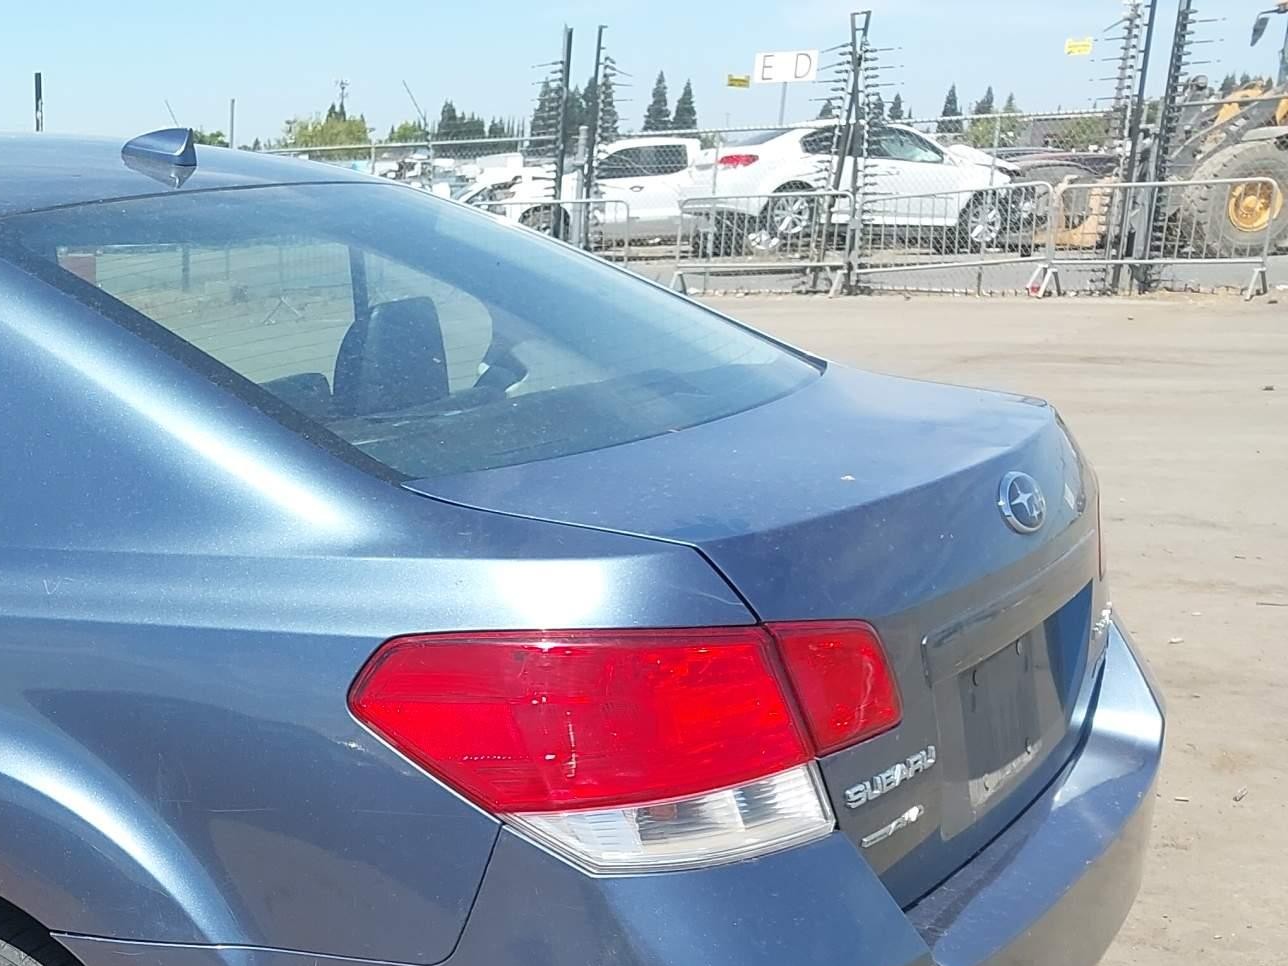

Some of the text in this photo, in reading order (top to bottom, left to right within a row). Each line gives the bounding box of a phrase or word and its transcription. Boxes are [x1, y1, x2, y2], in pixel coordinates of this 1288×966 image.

[761, 53, 812, 80] E D
[845, 745, 936, 809] SUBARU
